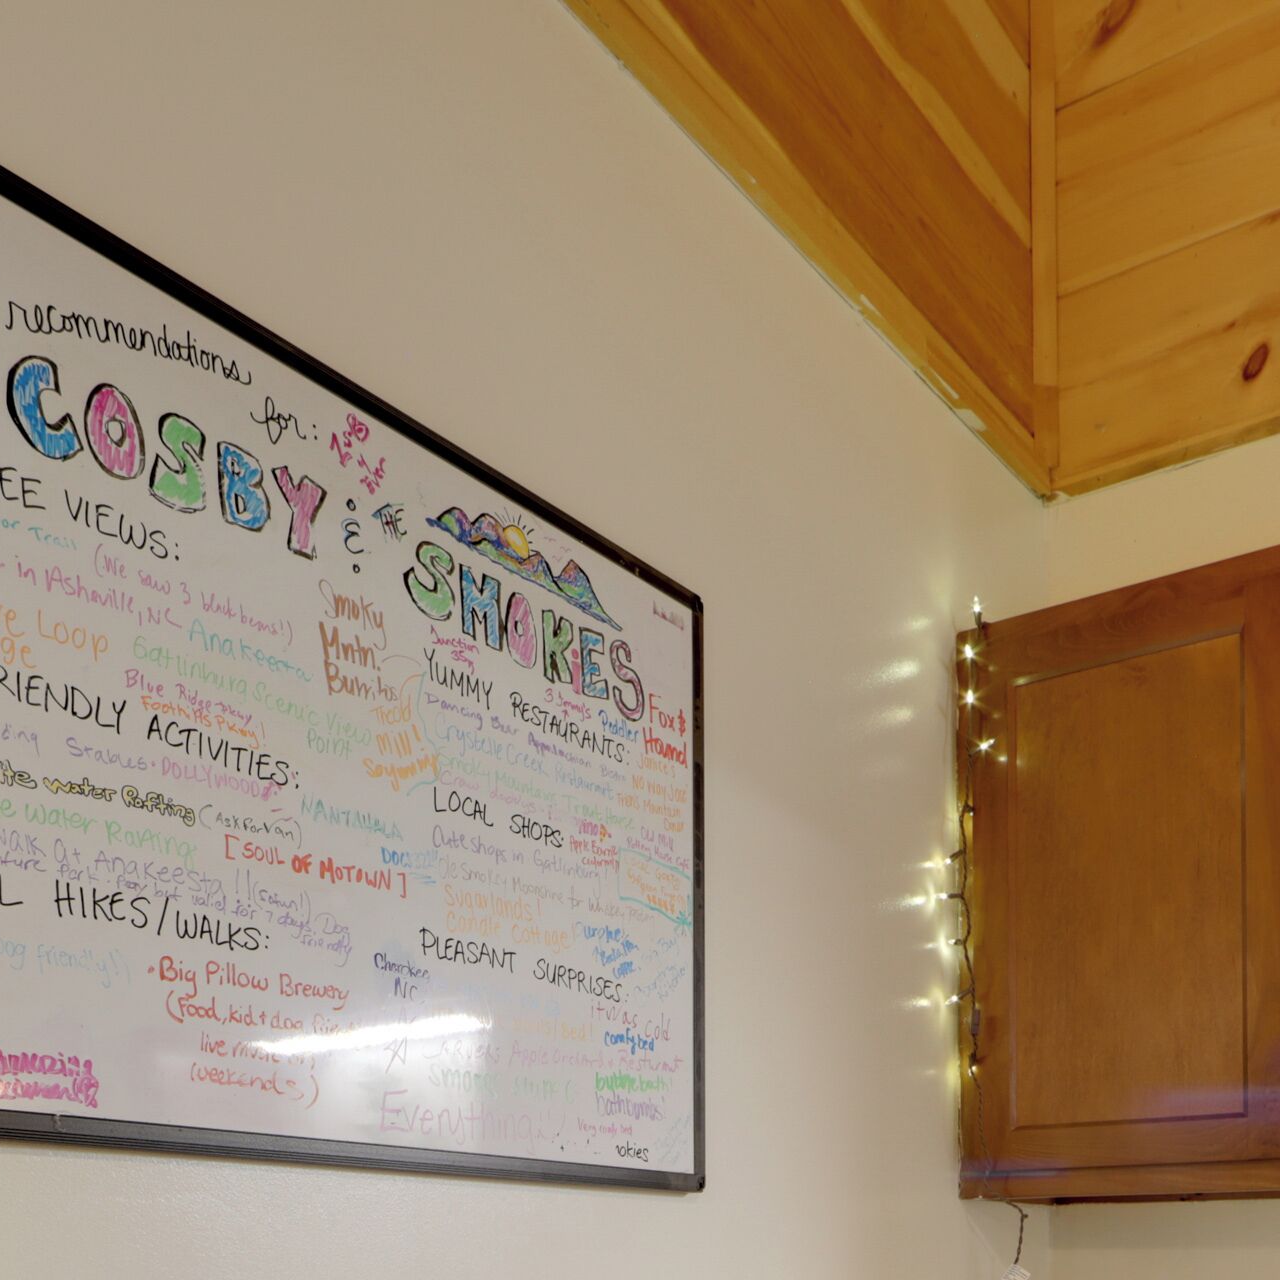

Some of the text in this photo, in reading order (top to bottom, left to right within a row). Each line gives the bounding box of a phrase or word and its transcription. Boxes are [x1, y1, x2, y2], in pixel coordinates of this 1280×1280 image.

[6, 301, 318, 445] recommendations for:
[6, 355, 327, 560] COSBY
[371, 502, 408, 542] THE
[64, 488, 181, 561] VIEWS:
[15, 555, 37, 586] in
[137, 569, 171, 595] saw
[179, 582, 192, 605] 3
[37, 609, 110, 661] Loop
[319, 579, 387, 650] Smoky
[124, 668, 212, 713] Blue Ridge
[424, 648, 631, 766] YUMMY RESTAURANTS:
[648, 693, 675, 732] Fox
[147, 714, 299, 789] ACTIVITIES:
[434, 786, 493, 827] LOCAL
[510, 814, 564, 848] SHOPS:
[291, 853, 312, 875] OF
[432, 825, 524, 864] Cute shops in
[159, 955, 349, 1011] Big Pillow Brewery
[419, 927, 517, 974] PLEASANT
[533, 959, 631, 1003] SURPRISES:
[228, 1004, 257, 1025] kid
[201, 1031, 226, 1056] live
